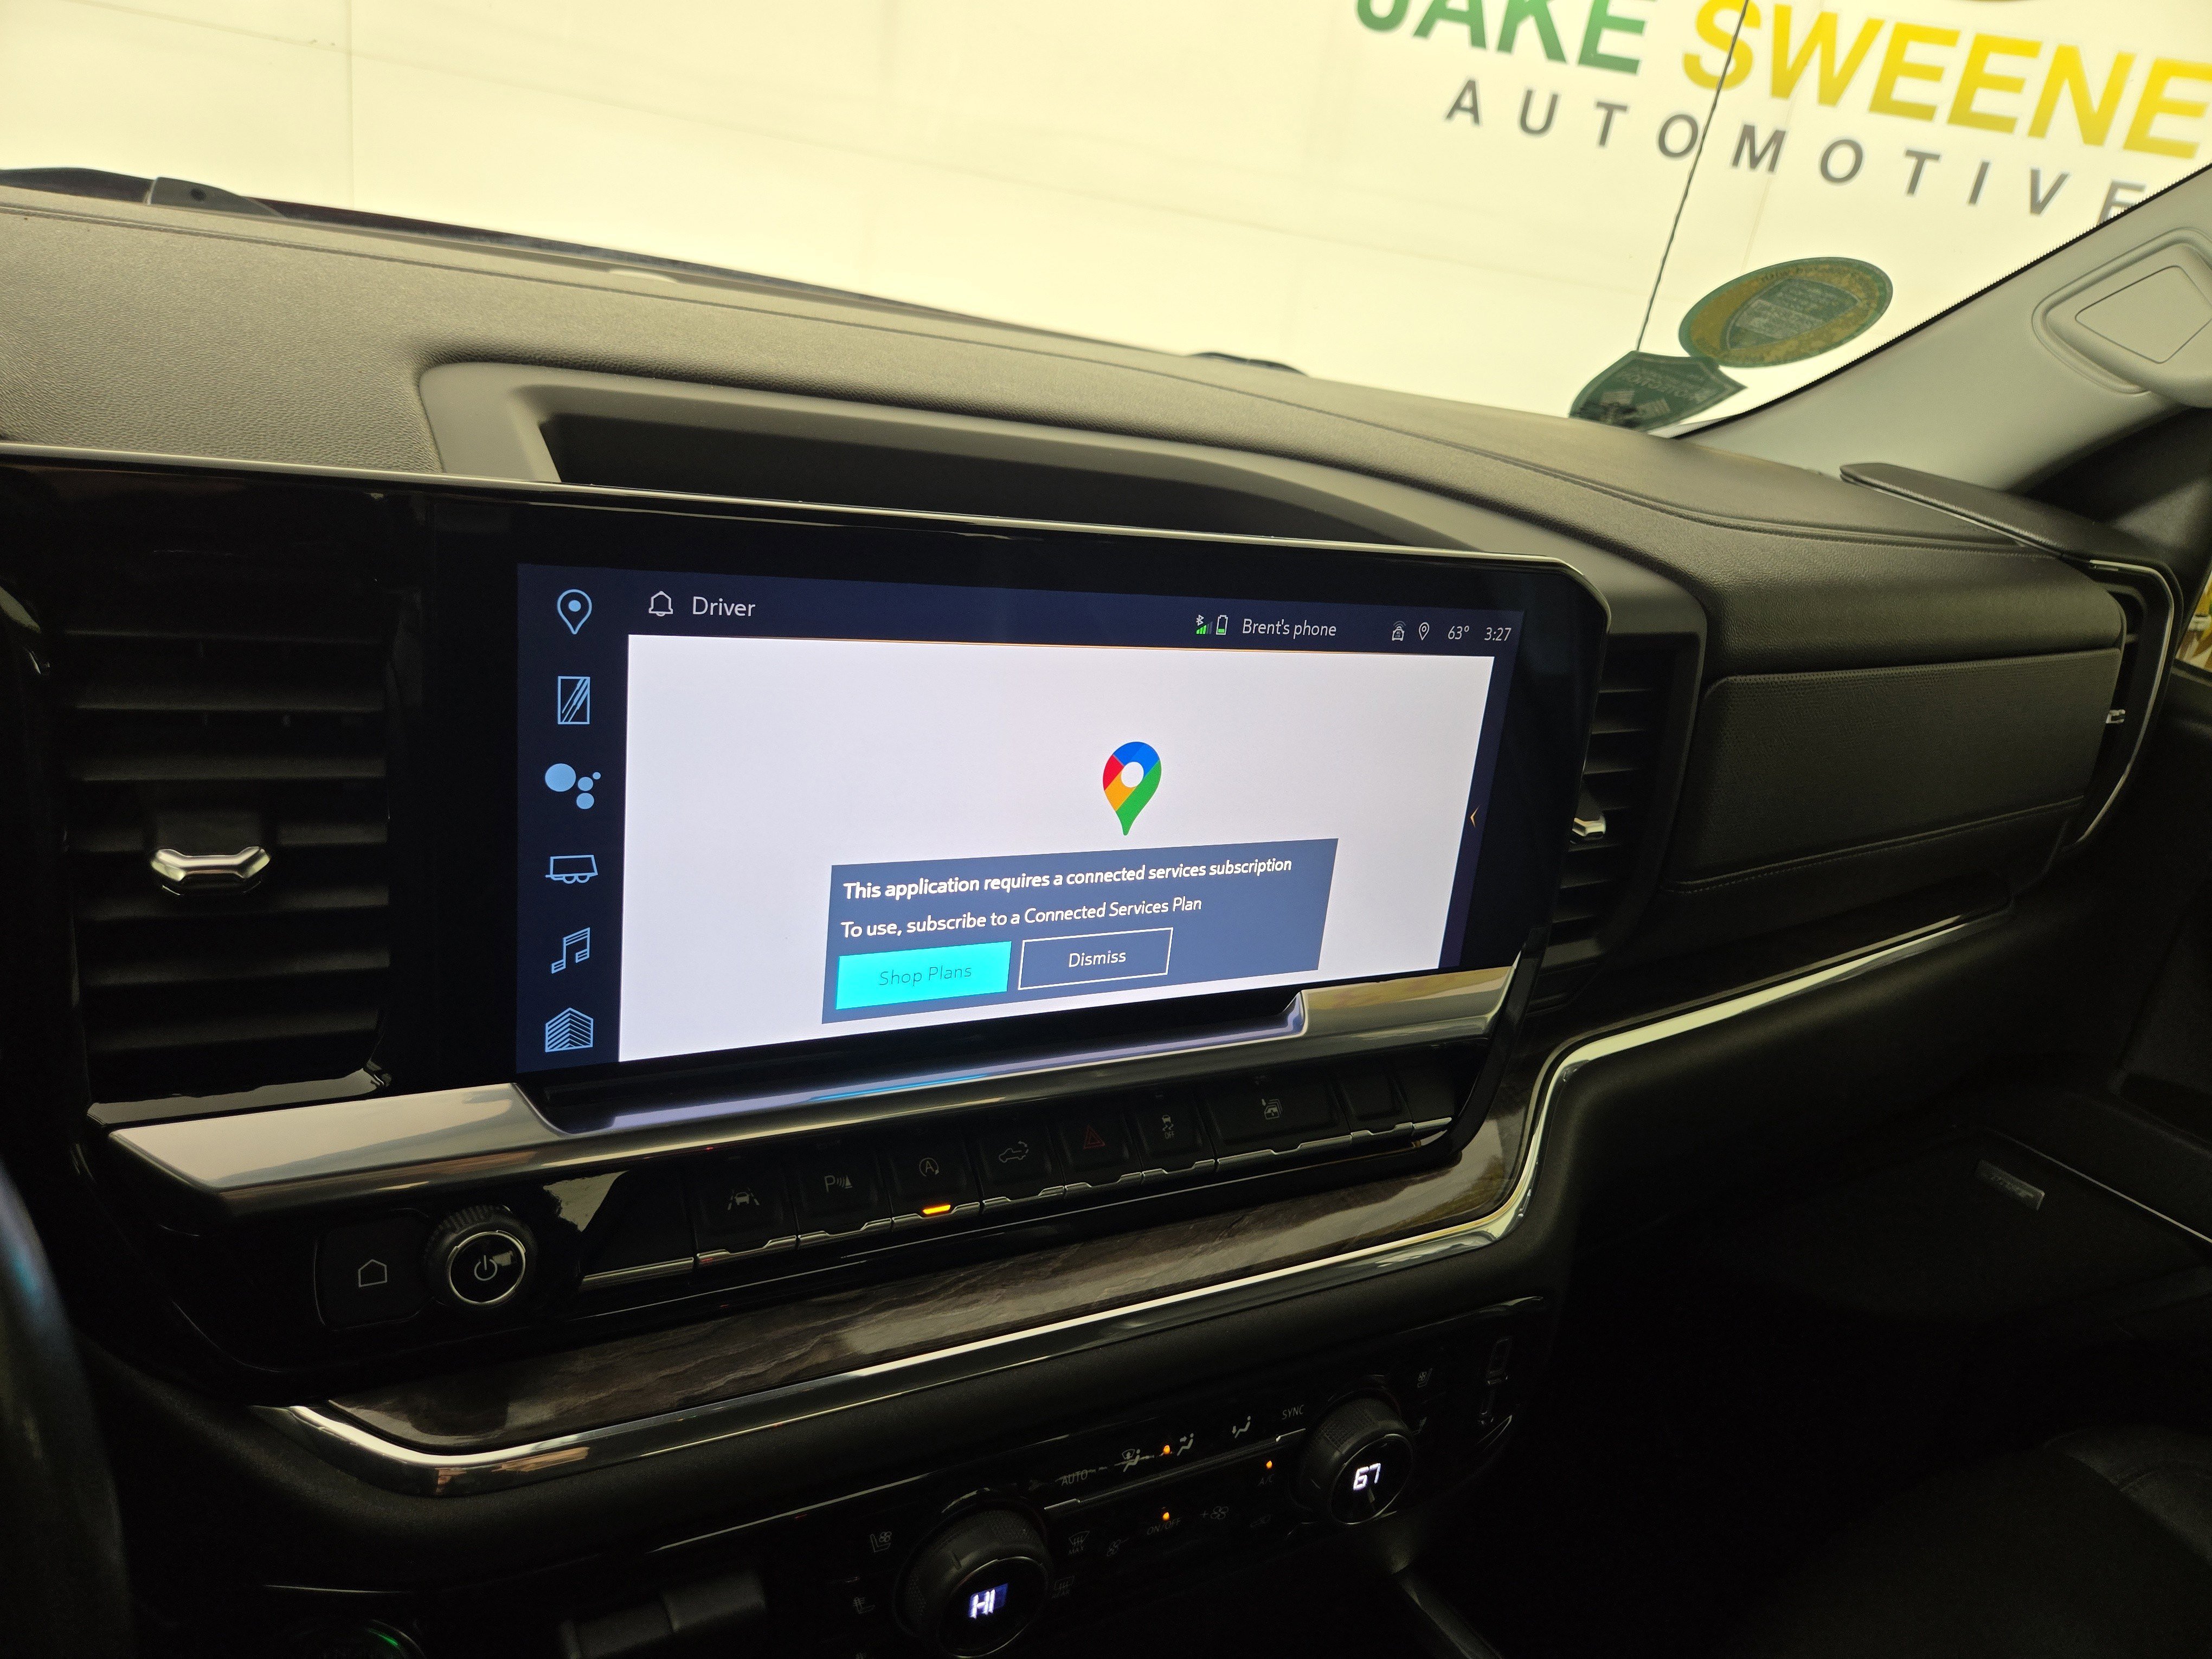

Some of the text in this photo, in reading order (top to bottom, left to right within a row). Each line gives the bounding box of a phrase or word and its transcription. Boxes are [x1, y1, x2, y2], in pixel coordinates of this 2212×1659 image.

[1683, 0, 2212, 159] SWEENE
[692, 596, 756, 616] Driver
[1242, 618, 1337, 639] Brent's phone
[1484, 627, 1512, 641] 3:27
[843, 858, 1291, 901] This application requires a connected services subscription
[841, 896, 1202, 938] To use, subscribe to a Connected Services Plan
[1069, 950, 1126, 968] Dismiss
[879, 966, 972, 987] Shop Plans
[1282, 1405, 1304, 1420] SYNC
[1060, 1469, 1089, 1487] AUTO
[1258, 1474, 1275, 1487] A/C
[1352, 1463, 1382, 1491] 67
[1146, 1517, 1181, 1536] ON/OFF
[968, 1589, 996, 1619] HI
